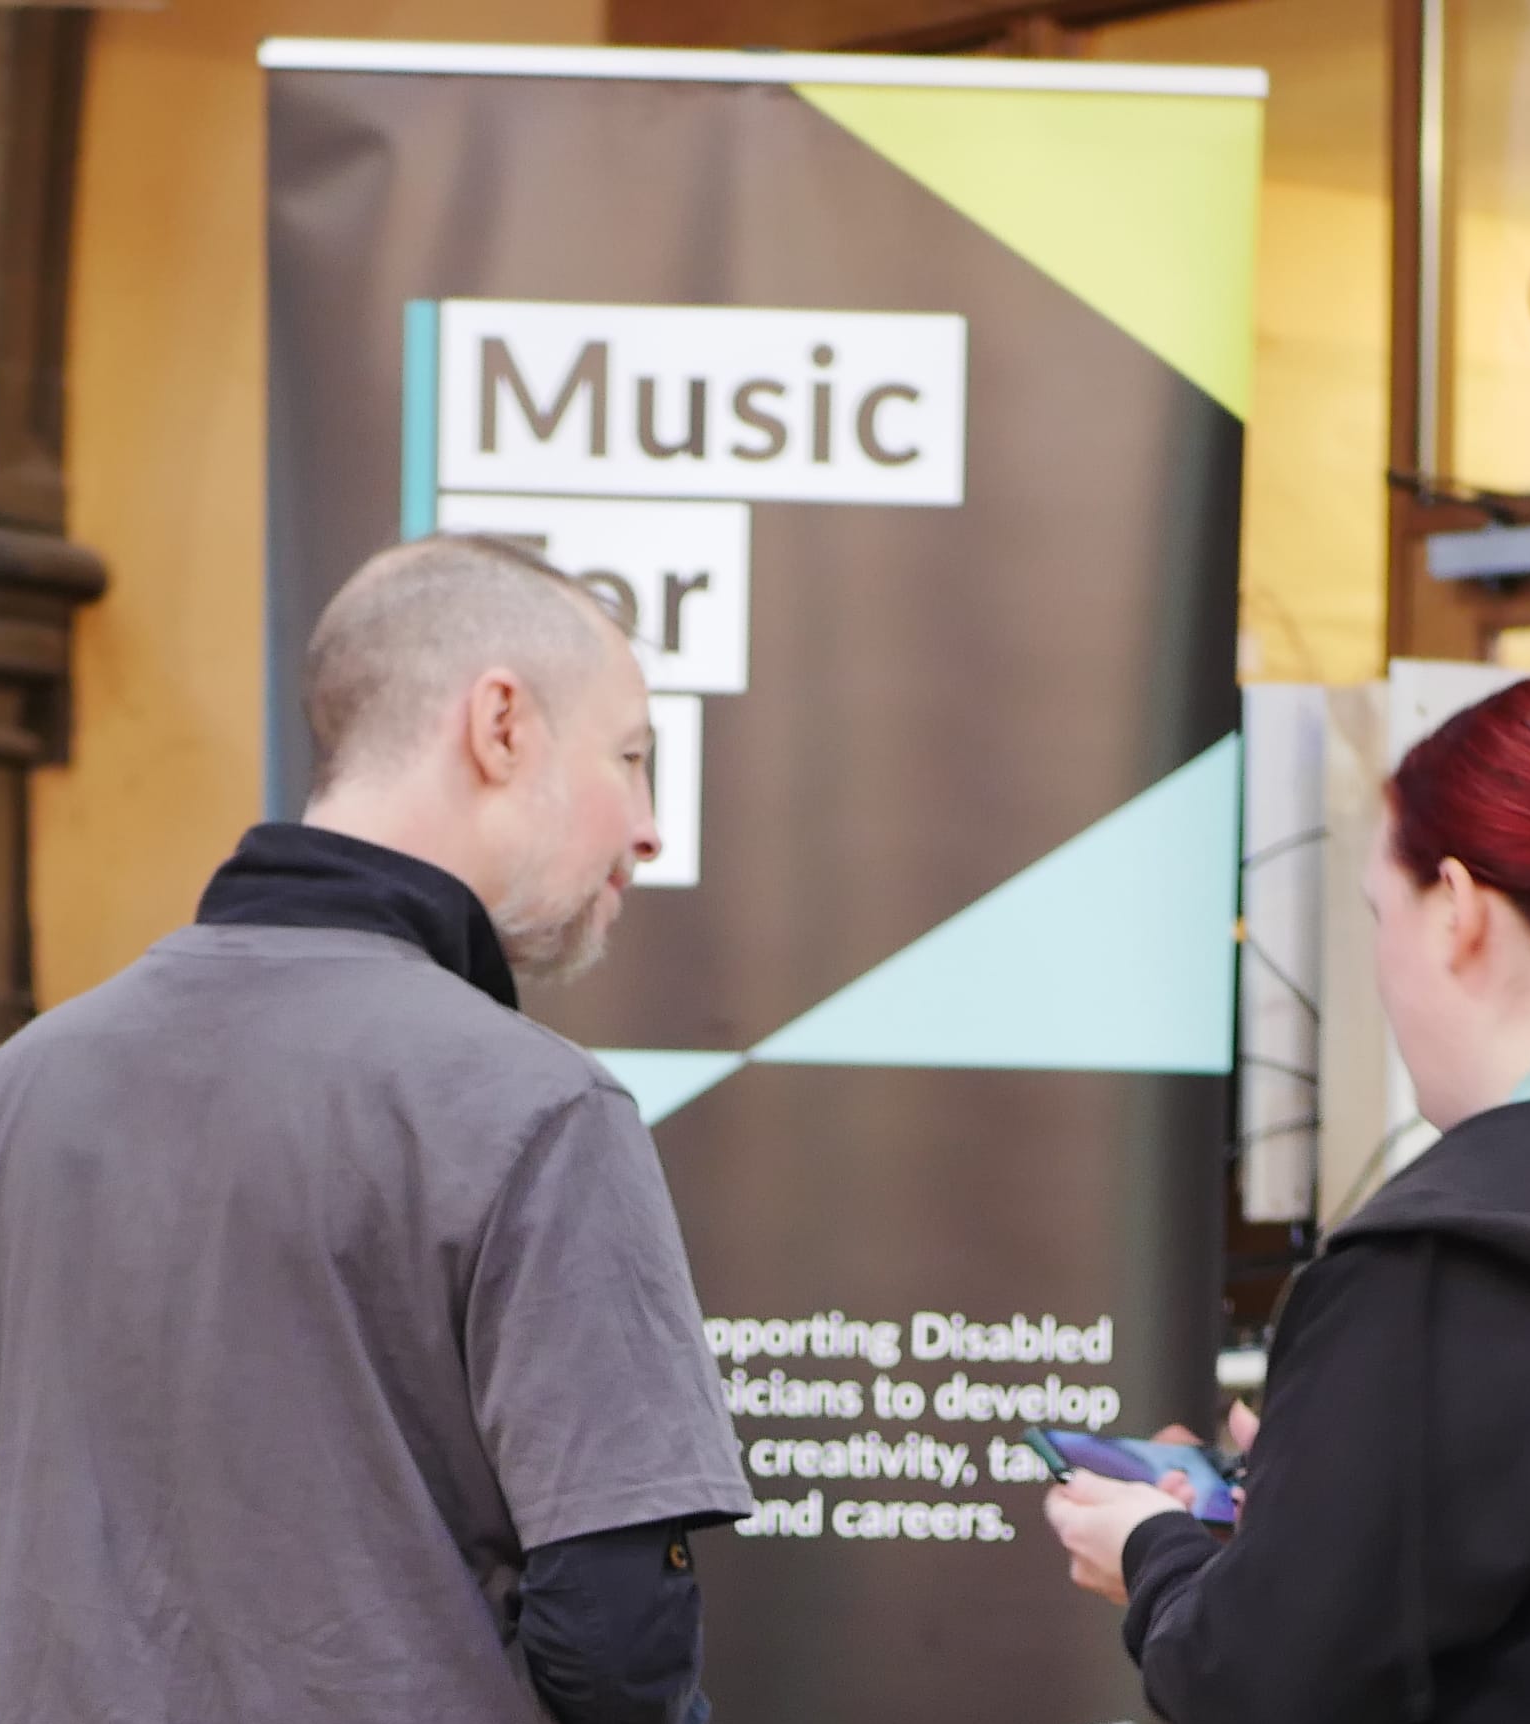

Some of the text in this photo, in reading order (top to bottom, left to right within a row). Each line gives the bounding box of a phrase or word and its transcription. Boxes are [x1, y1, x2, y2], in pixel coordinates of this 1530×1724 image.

[479, 337, 922, 466] Music
[472, 532, 710, 655] or
[911, 1311, 1113, 1365] Disabled
[872, 1373, 926, 1420] to
[933, 1371, 1120, 1431] develop
[748, 1430, 977, 1488] creativity,
[832, 1499, 1016, 1542] careers.
